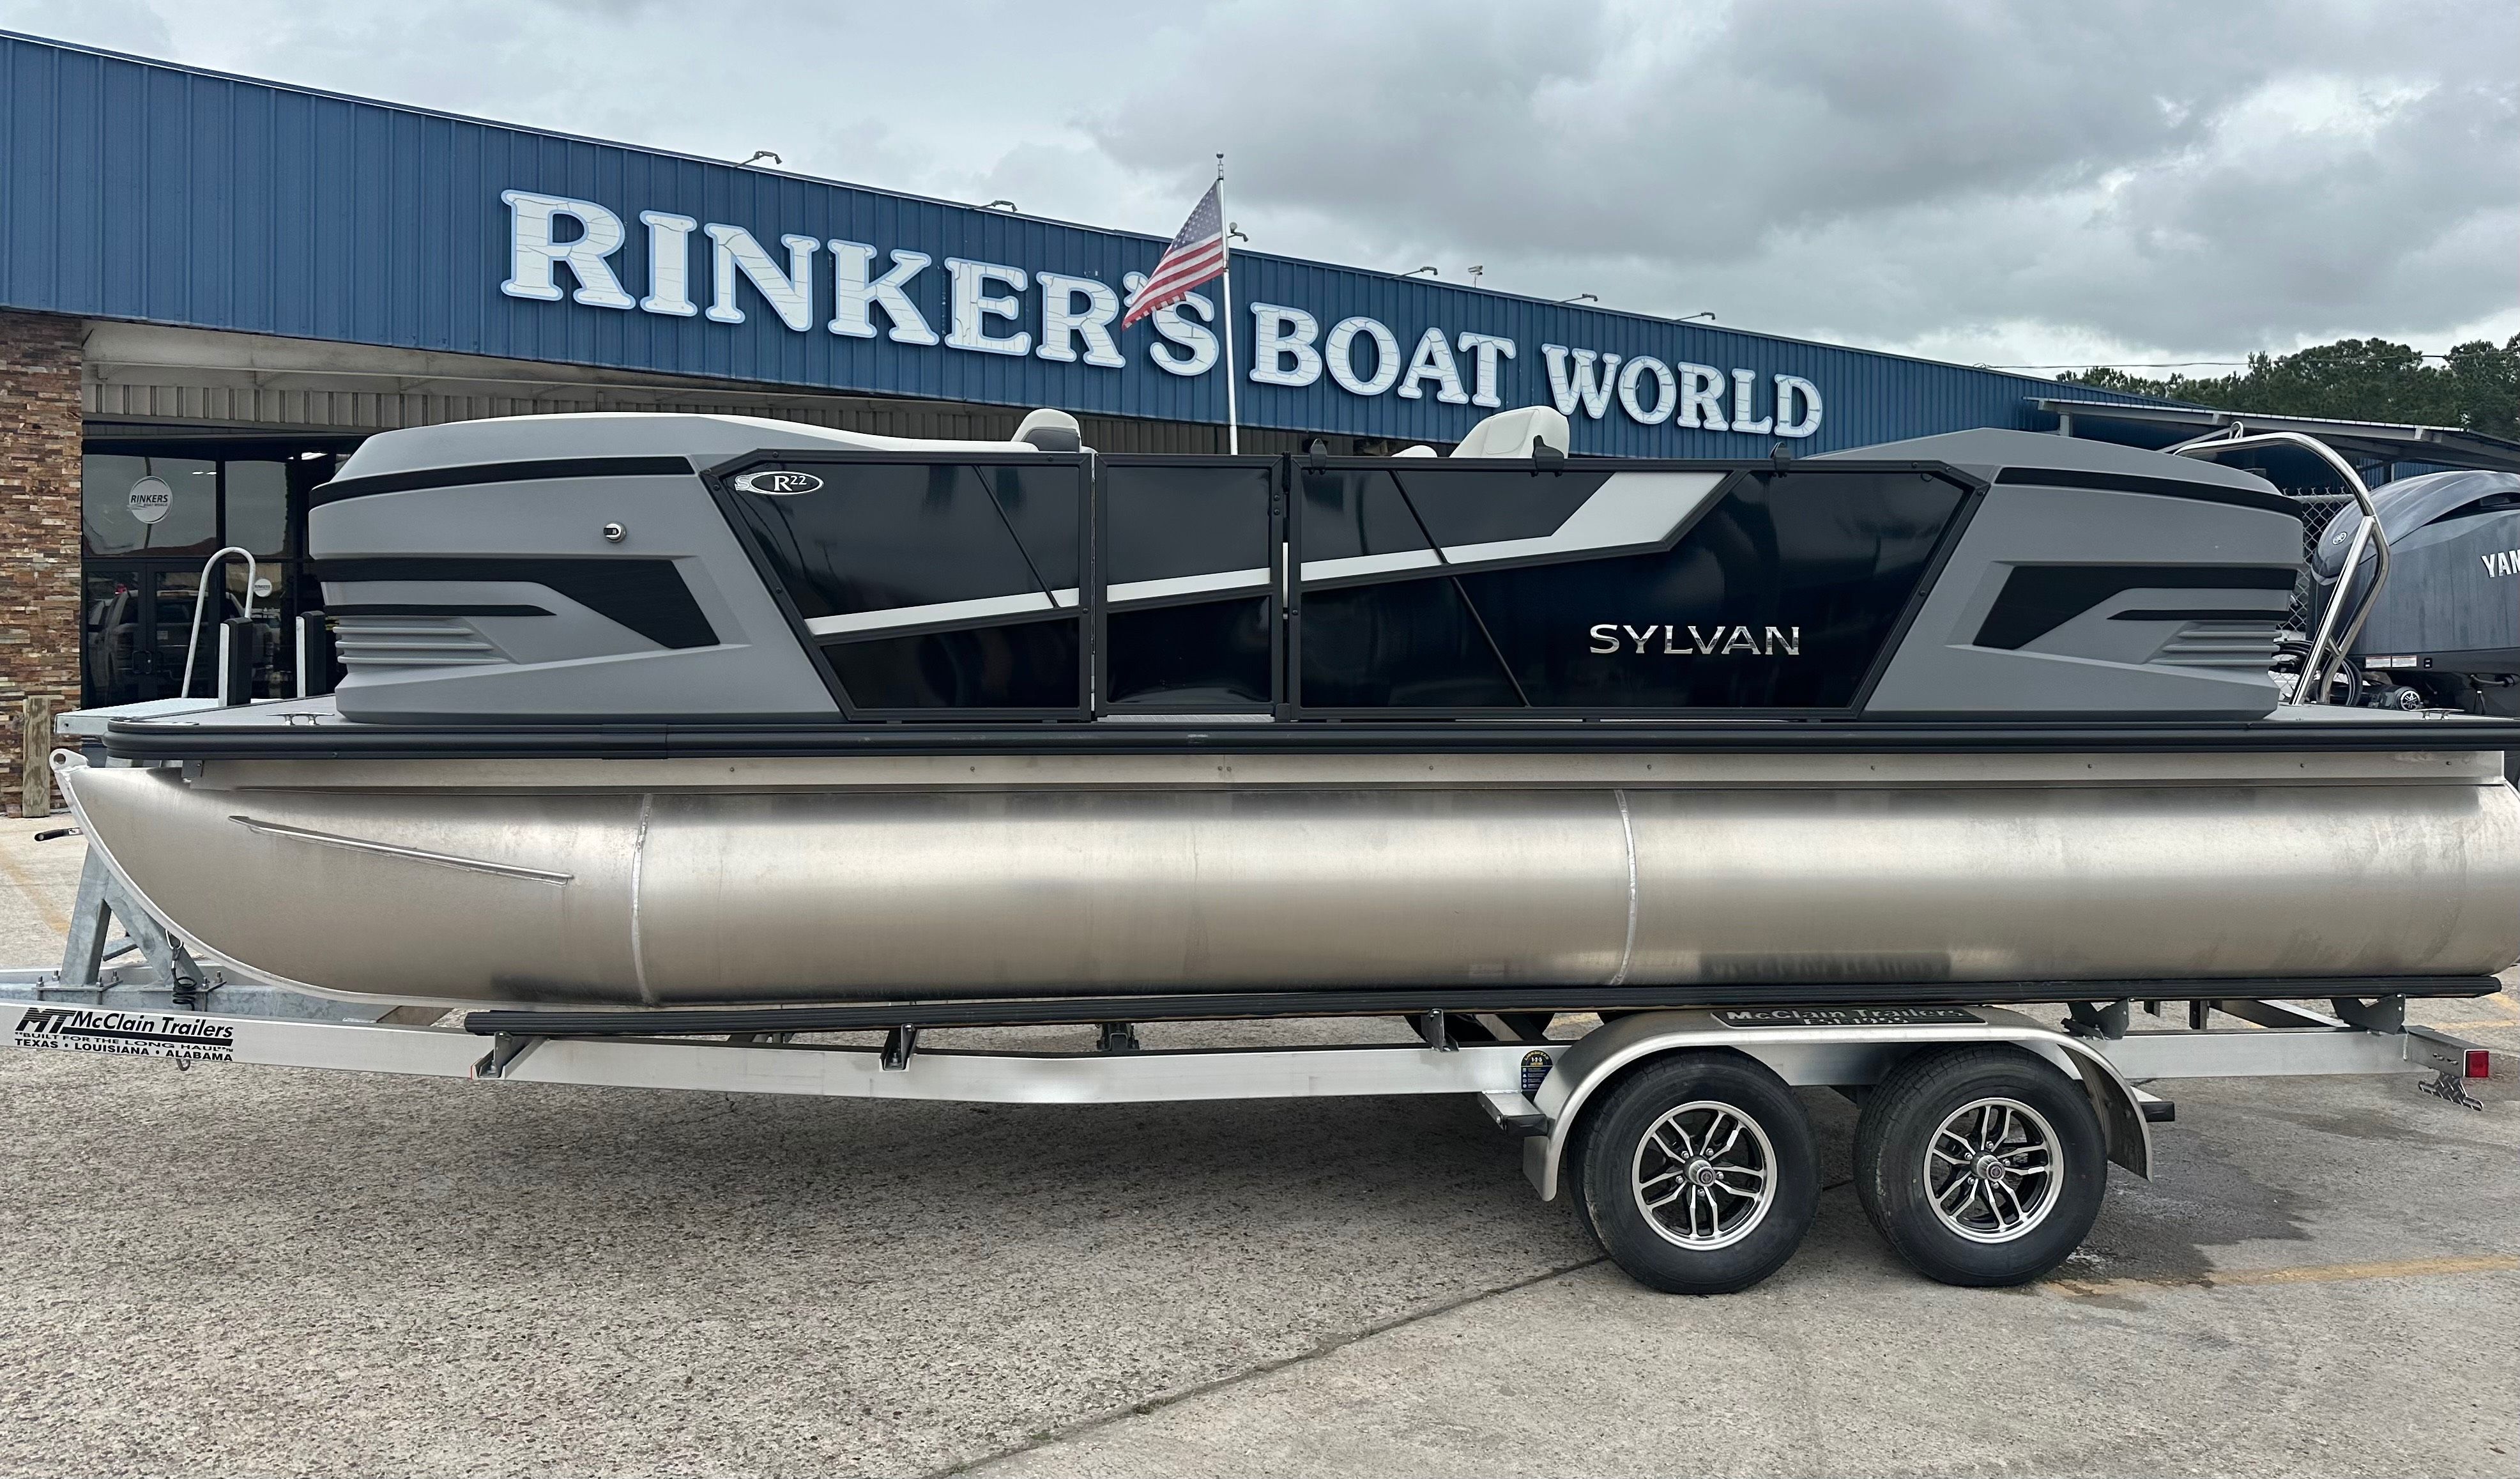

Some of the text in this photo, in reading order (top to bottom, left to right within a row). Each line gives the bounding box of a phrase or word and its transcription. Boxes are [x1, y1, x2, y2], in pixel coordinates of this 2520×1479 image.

[500, 188, 1822, 438] RINKER'S BOAT WORLD
[130, 494, 168, 503] RINKERS
[1590, 624, 1799, 655] SYLVAN
[15, 1008, 233, 1038] MT McClain Trailers
[1726, 1008, 1964, 1020] McClain Trailers
[15, 1038, 233, 1061] TEXAS LOUISIANA ALABAMA
